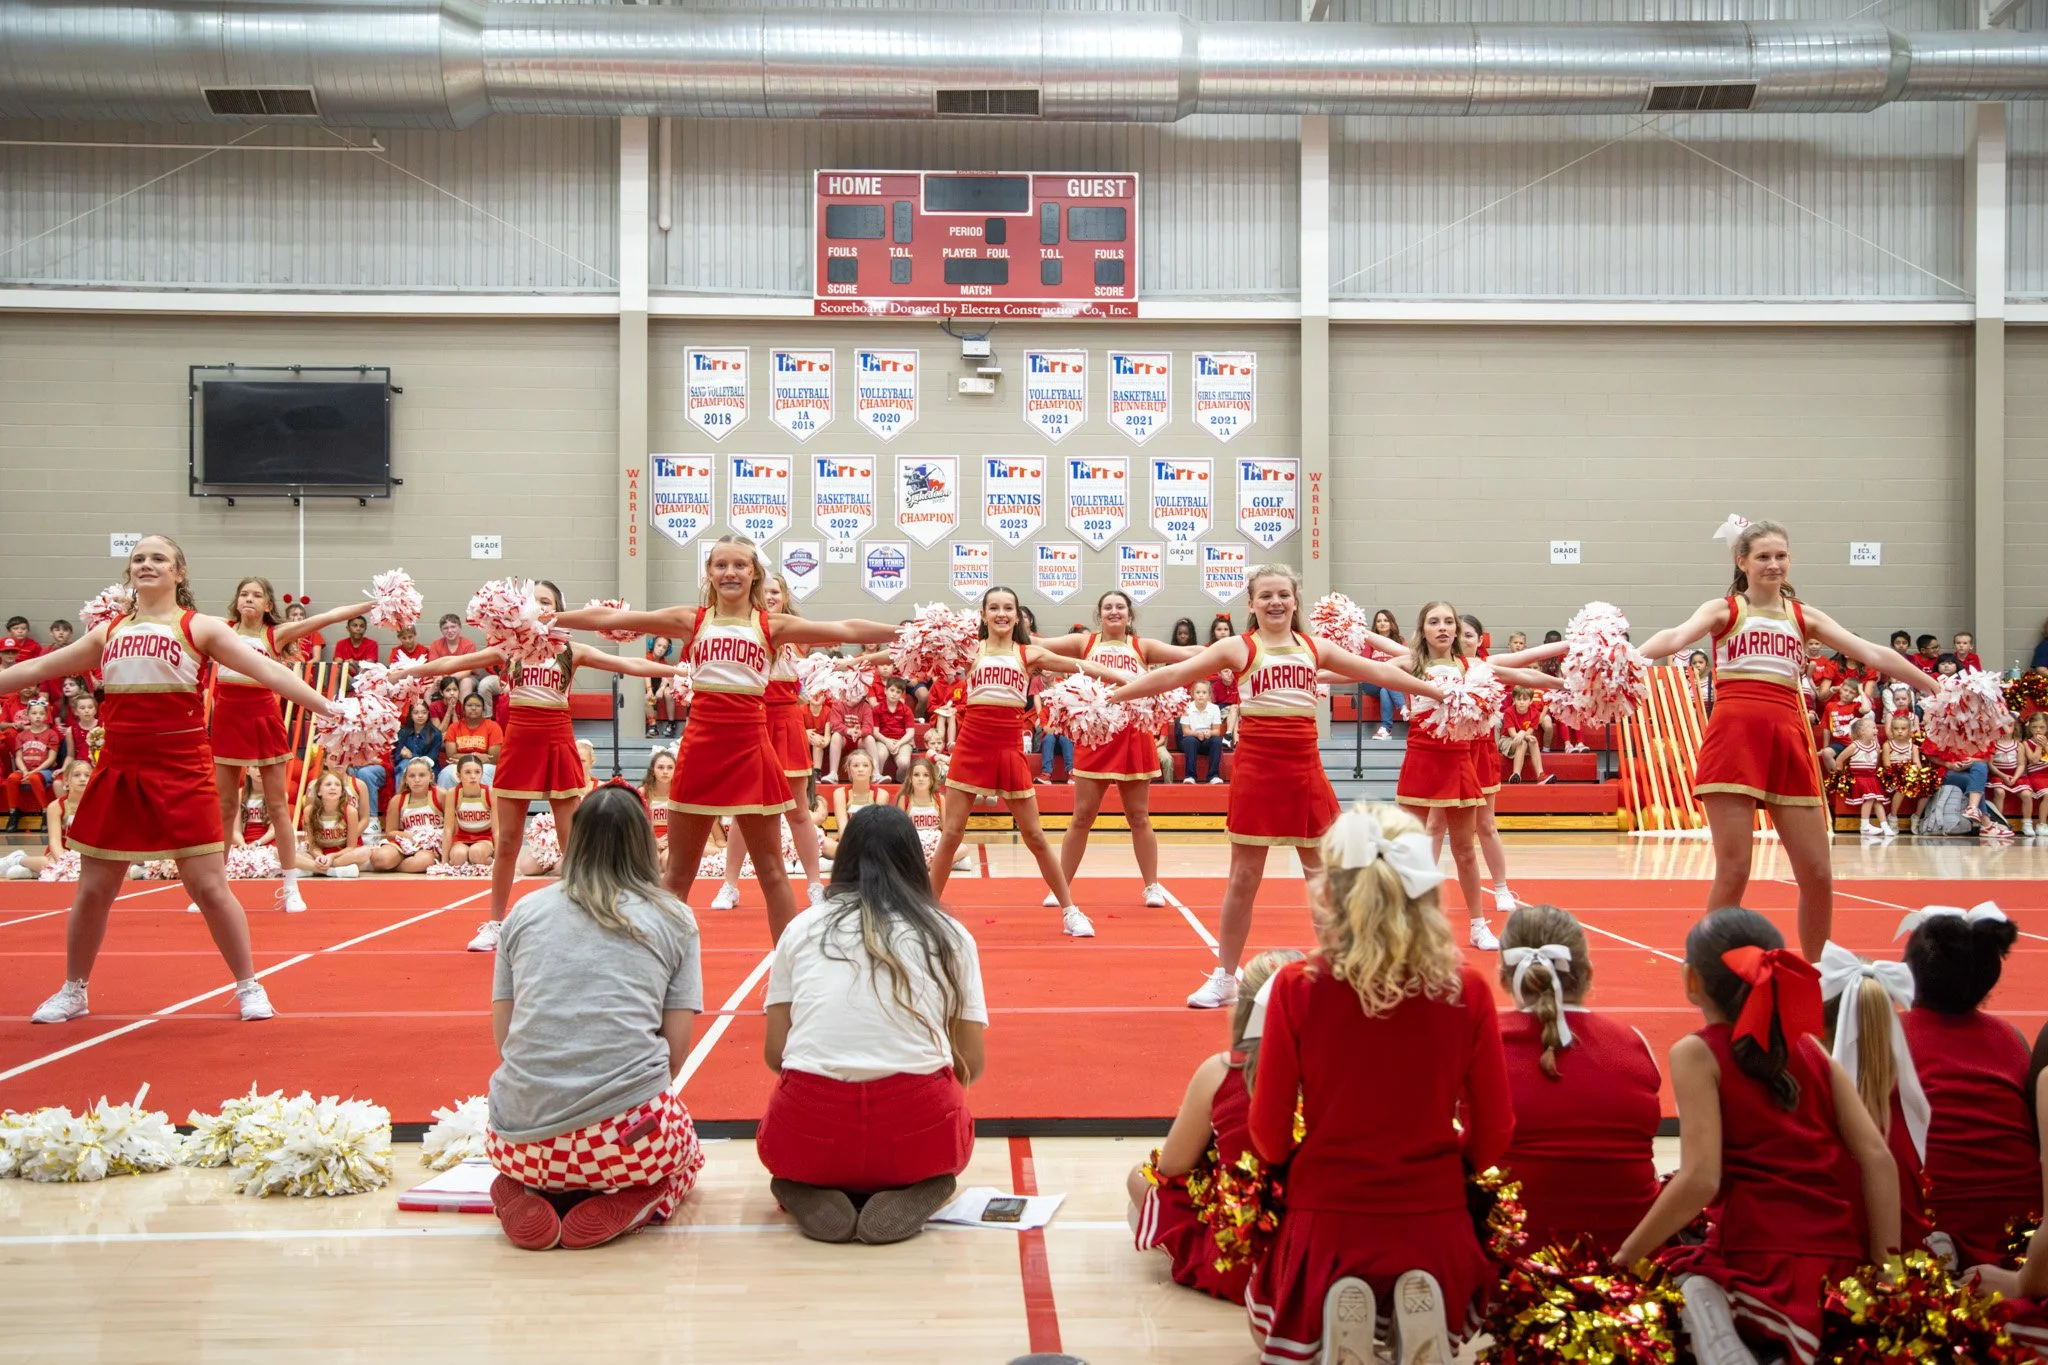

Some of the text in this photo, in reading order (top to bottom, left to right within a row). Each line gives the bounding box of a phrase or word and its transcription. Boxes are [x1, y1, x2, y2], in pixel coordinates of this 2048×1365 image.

[829, 176, 882, 196] HOME
[1067, 179, 1127, 198] GUEST
[949, 226, 983, 237] PERIOD
[828, 247, 858, 257] FOULS
[889, 248, 913, 258] T.O.L.
[942, 248, 1010, 258] PLAYER FOUL
[1040, 249, 1064, 259] T.O.L.
[1095, 249, 1124, 259] FOULS
[828, 284, 857, 294] SCORE
[960, 286, 992, 295] MATCH
[1094, 287, 1124, 297] SCORE
[820, 302, 887, 313] Scoreboard
[890, 303, 940, 314] Donated
[944, 304, 957, 316] by
[961, 303, 1001, 314] Electra
[1004, 304, 1079, 315] Construction
[1110, 305, 1131, 315] Inc.
[691, 386, 744, 397] SAND VOLLEYBALL
[777, 388, 829, 399] VOLLEYBALL
[860, 388, 913, 399] VOLLEYBALL
[1029, 389, 1082, 400] VOLLEYBALL
[1113, 391, 1166, 401] BASKETBALL
[1198, 391, 1250, 400] GIRLS ATHLETICS
[691, 398, 745, 409] CHAMPIONS
[776, 399, 830, 411] CHAMPION
[860, 399, 913, 411] CHAMPION
[1029, 400, 1082, 412] CHAMPION
[1113, 402, 1166, 413] RUNNERUP
[1198, 401, 1250, 411] CHAMPION
[704, 413, 731, 425] 2018
[798, 411, 809, 420] 1A
[872, 413, 900, 423] 2020
[1042, 414, 1068, 424] 2021
[1126, 416, 1152, 425] 2021
[1210, 416, 1237, 424] 2021
[792, 421, 815, 430] 2018
[655, 493, 709, 503] VOLLEYBALL
[733, 494, 786, 504] BASKETBALL
[817, 494, 871, 504] BASKETBALL
[987, 494, 1041, 505] TENNIS
[1071, 496, 1124, 506] VOLLEYBALL
[1155, 497, 1208, 507] VOLLEYBALL
[1253, 497, 1284, 507] GOLF
[626, 469, 640, 556] WARRIORS
[655, 504, 709, 516] CHAMPION
[733, 505, 787, 516] CHAMPIONS
[817, 505, 871, 516] CHAMPIONS
[987, 505, 1040, 516] CHAMPION
[1071, 507, 1124, 518] CHAMPION
[1155, 508, 1208, 519] CHAMPION
[1241, 508, 1295, 519] CHAMPION
[900, 513, 954, 524] CHAMPION
[1309, 473, 1322, 559] WARRIORS
[668, 519, 696, 528] 2022
[746, 519, 773, 528] 2022
[830, 519, 858, 528] 2022
[1000, 519, 1028, 529] 2023
[1084, 520, 1111, 530] 2023
[1167, 522, 1195, 531] 2024
[1254, 522, 1282, 531] 2025
[1728, 632, 1802, 665] WARRIORS
[694, 638, 765, 672] WARRIORS
[970, 667, 1024, 692] WARRIORS
